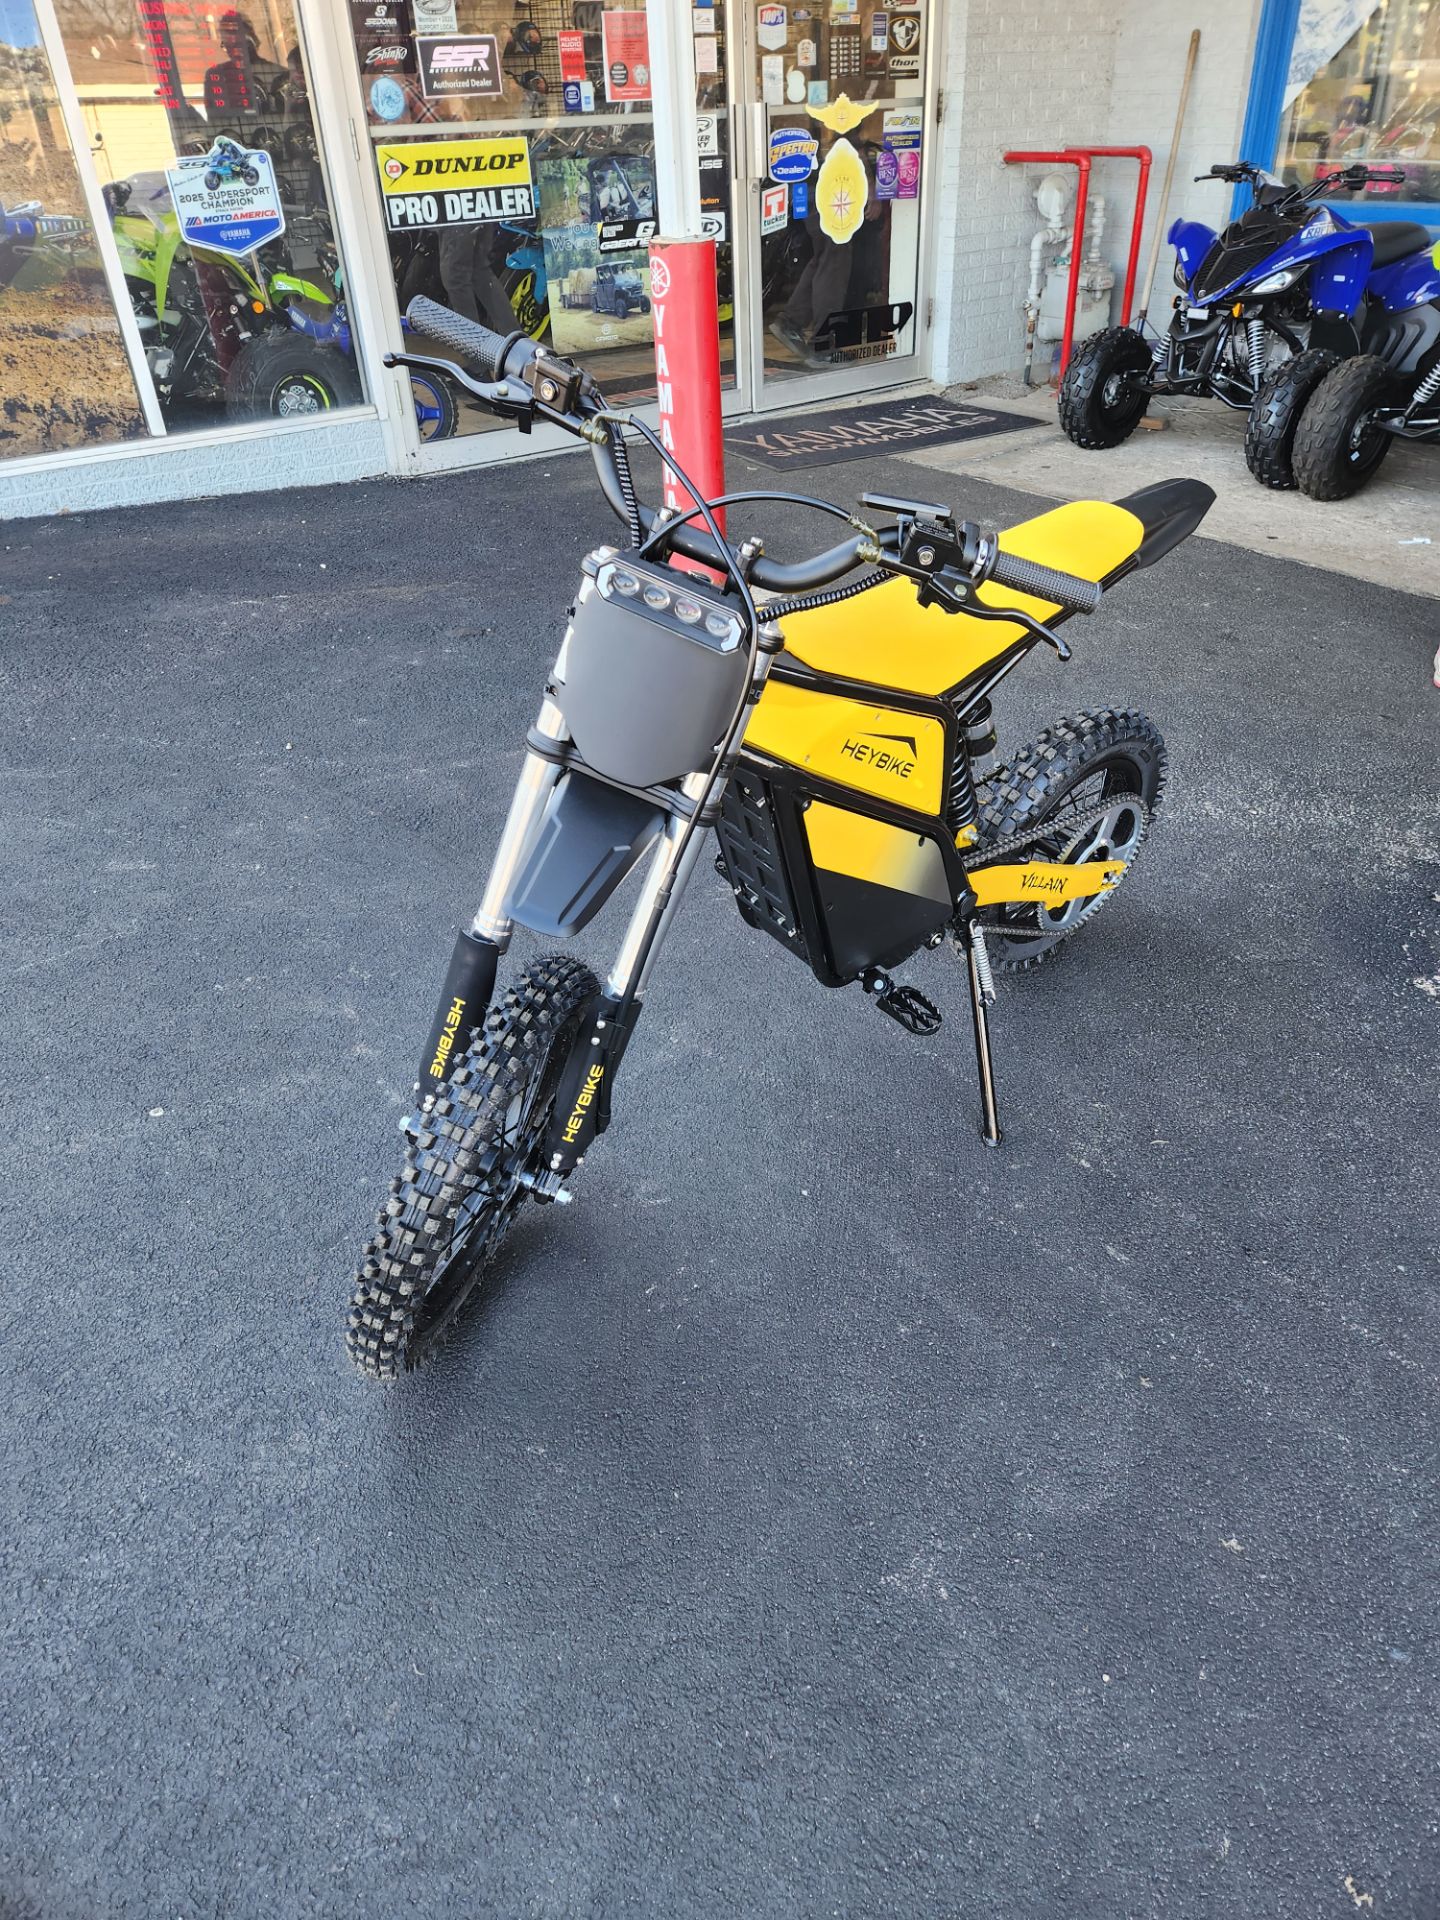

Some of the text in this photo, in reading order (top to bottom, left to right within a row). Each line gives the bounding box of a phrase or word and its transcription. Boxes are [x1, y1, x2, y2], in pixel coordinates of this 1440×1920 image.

[430, 45, 490, 71] SSR
[891, 59, 918, 67] thor
[433, 78, 493, 89] Authorized Dealer
[413, 153, 524, 176] DUNLOP
[777, 166, 806, 175] Dealer
[179, 187, 271, 204] 2025 SUPERSPORT
[200, 197, 255, 210] CHAMPION
[388, 187, 532, 226] PRO DEALER
[872, 342, 897, 357] DEALER
[723, 409, 980, 450] YAMAHA
[767, 415, 997, 457] SNOWMOBILES
[841, 739, 914, 778] HEYBIKE
[1021, 872, 1068, 894] VILLAIN
[429, 997, 466, 1079] HEYBIKE
[562, 1064, 604, 1143] HEYBIKE
